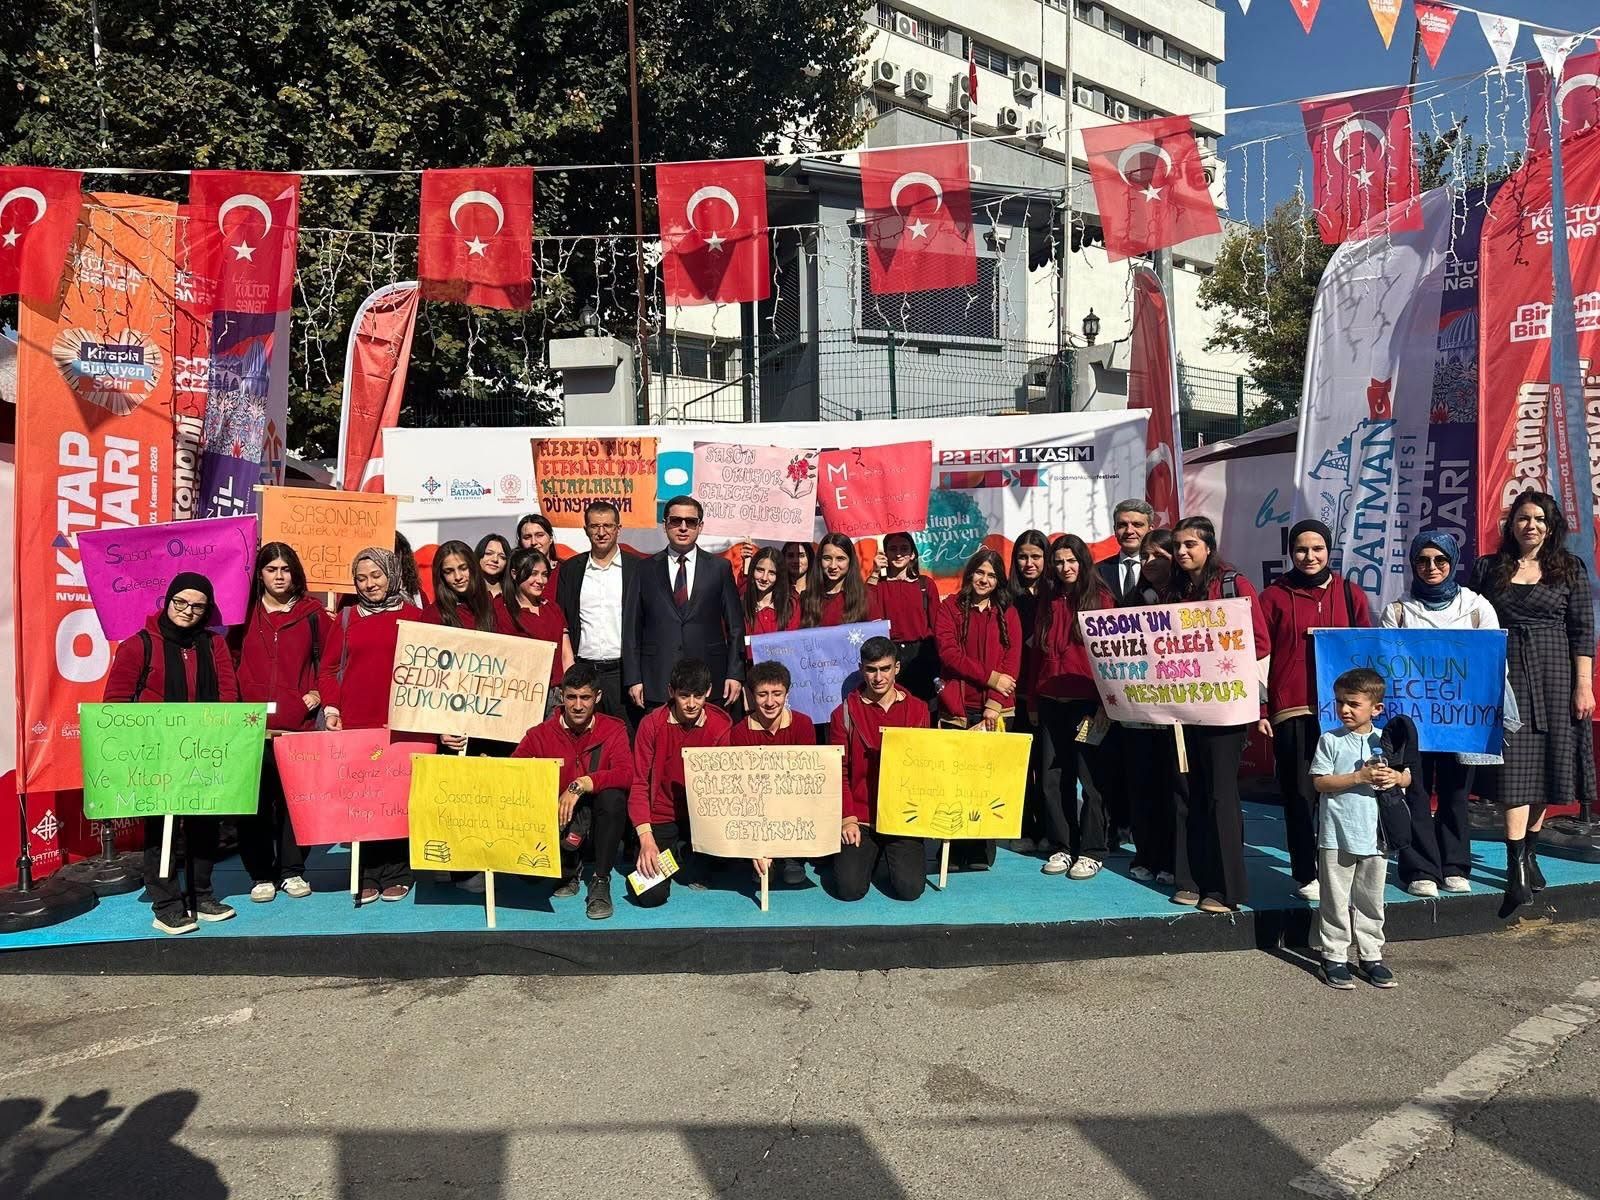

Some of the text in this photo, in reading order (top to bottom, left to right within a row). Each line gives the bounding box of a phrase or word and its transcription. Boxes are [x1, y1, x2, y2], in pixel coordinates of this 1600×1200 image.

[1521, 305, 1550, 322] Bir
[1514, 322, 1546, 338] Bin
[1553, 386, 1563, 417] 2026
[705, 446, 757, 465] SASON
[942, 450, 966, 465] 22
[1019, 449, 1028, 462] 1
[1032, 446, 1091, 462] KASIM
[1502, 382, 1550, 508] Batman
[149, 446, 158, 472] 2026
[175, 413, 204, 520] ronomi
[721, 465, 784, 487] OKUYOR
[451, 486, 484, 496] BATMAN
[56, 431, 98, 587] KTAP
[542, 494, 632, 513] DÜNYANA
[740, 505, 802, 524] OLUYOR
[1352, 418, 1398, 596] BATMAN
[1390, 434, 1417, 574] BELEDİYESİ
[930, 511, 970, 531] itapla
[1567, 514, 1577, 529] 22
[105, 538, 217, 565] Sason Okuyor
[918, 540, 990, 563] ehir
[310, 563, 351, 580] GETİ
[1085, 610, 1172, 637] SASON'UN
[1090, 628, 1246, 659] CEVİZİ ÇİLEĞİ VE
[1098, 658, 1201, 682] KİTAP AŞKI
[100, 736, 230, 767] Cevizi Çileği
[688, 750, 826, 772] SASON'DAN BAL
[88, 767, 111, 789] Ve
[127, 766, 173, 792] Kitap
[692, 771, 826, 797] ÇİLEK VE KİTAP
[697, 794, 766, 817] SEVGİSİ
[725, 817, 817, 841] GETİRDİK
